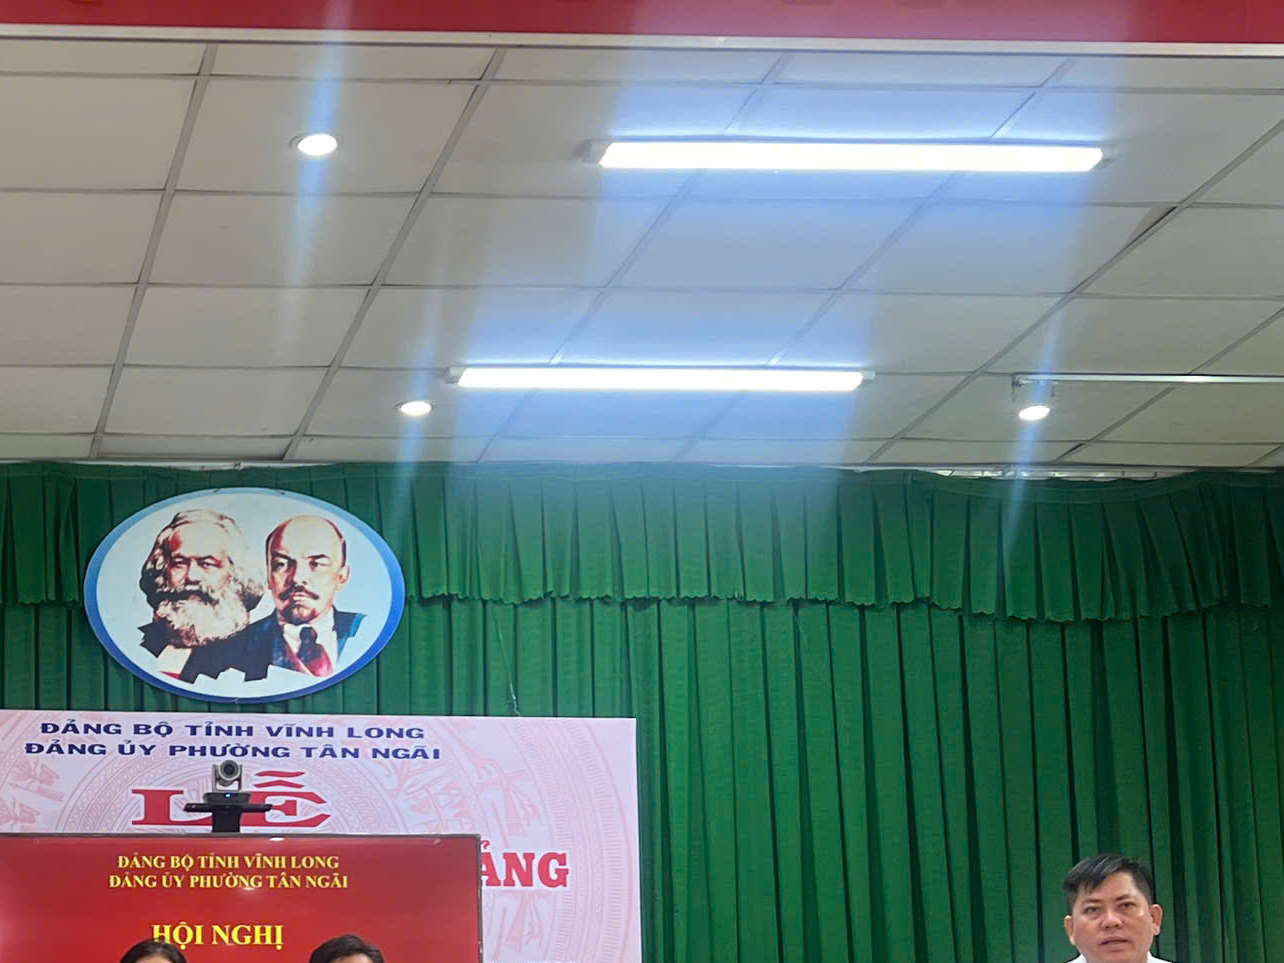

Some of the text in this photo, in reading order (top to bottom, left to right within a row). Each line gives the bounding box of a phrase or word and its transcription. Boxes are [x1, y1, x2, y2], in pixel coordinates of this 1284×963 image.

[41, 719, 425, 739] ĐẢNG BỘ TỈNH VĨNH LONG
[25, 739, 440, 760] ĐẢNG ỦY PHƯỜNG TÂN NGÃI
[132, 770, 331, 828] LỄ
[118, 852, 339, 871] ĐẢNG BỘ TỈNH VĨNH LONG
[481, 840, 569, 888] ẢNG
[190, 872, 263, 888] PHƯỜNG
[266, 872, 301, 888] TÂN
[306, 872, 348, 888] NGÃI
[151, 921, 284, 950] HỘI NGHỊ
